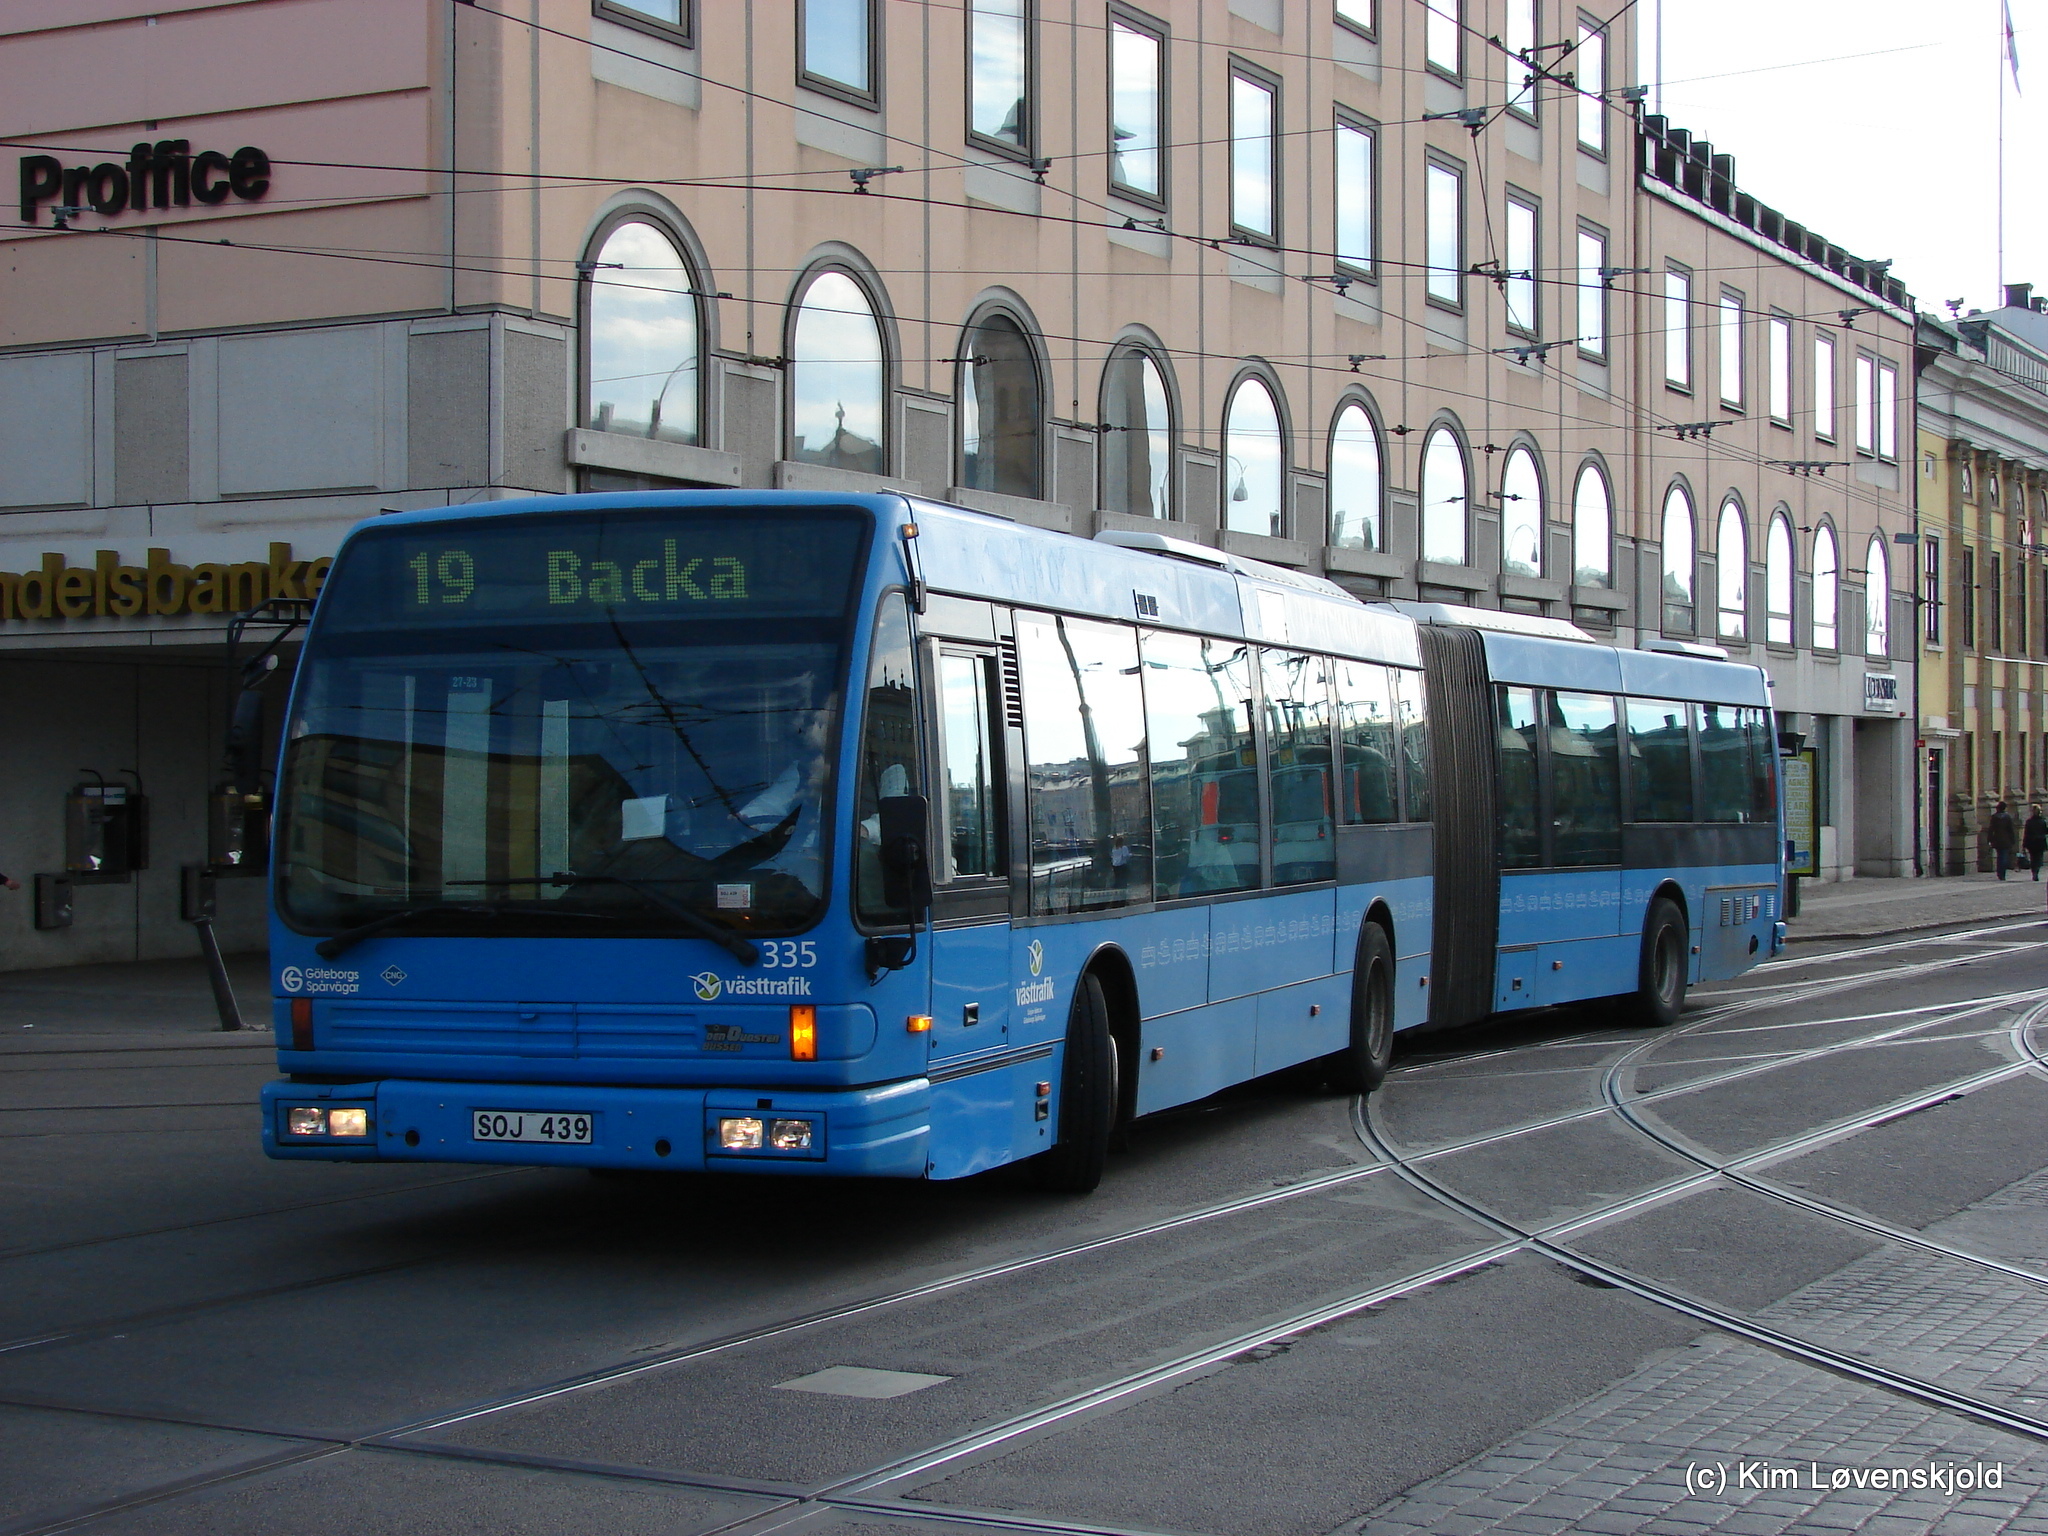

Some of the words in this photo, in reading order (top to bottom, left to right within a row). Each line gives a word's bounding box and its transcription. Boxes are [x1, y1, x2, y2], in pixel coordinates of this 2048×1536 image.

[20, 139, 271, 222] Proffice
[410, 550, 475, 604] 19
[548, 538, 749, 604] Backa
[762, 941, 817, 968] 335
[305, 968, 359, 982] Göteborgs
[306, 981, 360, 995] Spårvägar
[385, 971, 402, 980] CNG
[725, 976, 811, 996] västtrafik
[1016, 976, 1054, 1006] västtrafik
[478, 1114, 522, 1138] SOJ
[540, 1117, 589, 1140] 439
